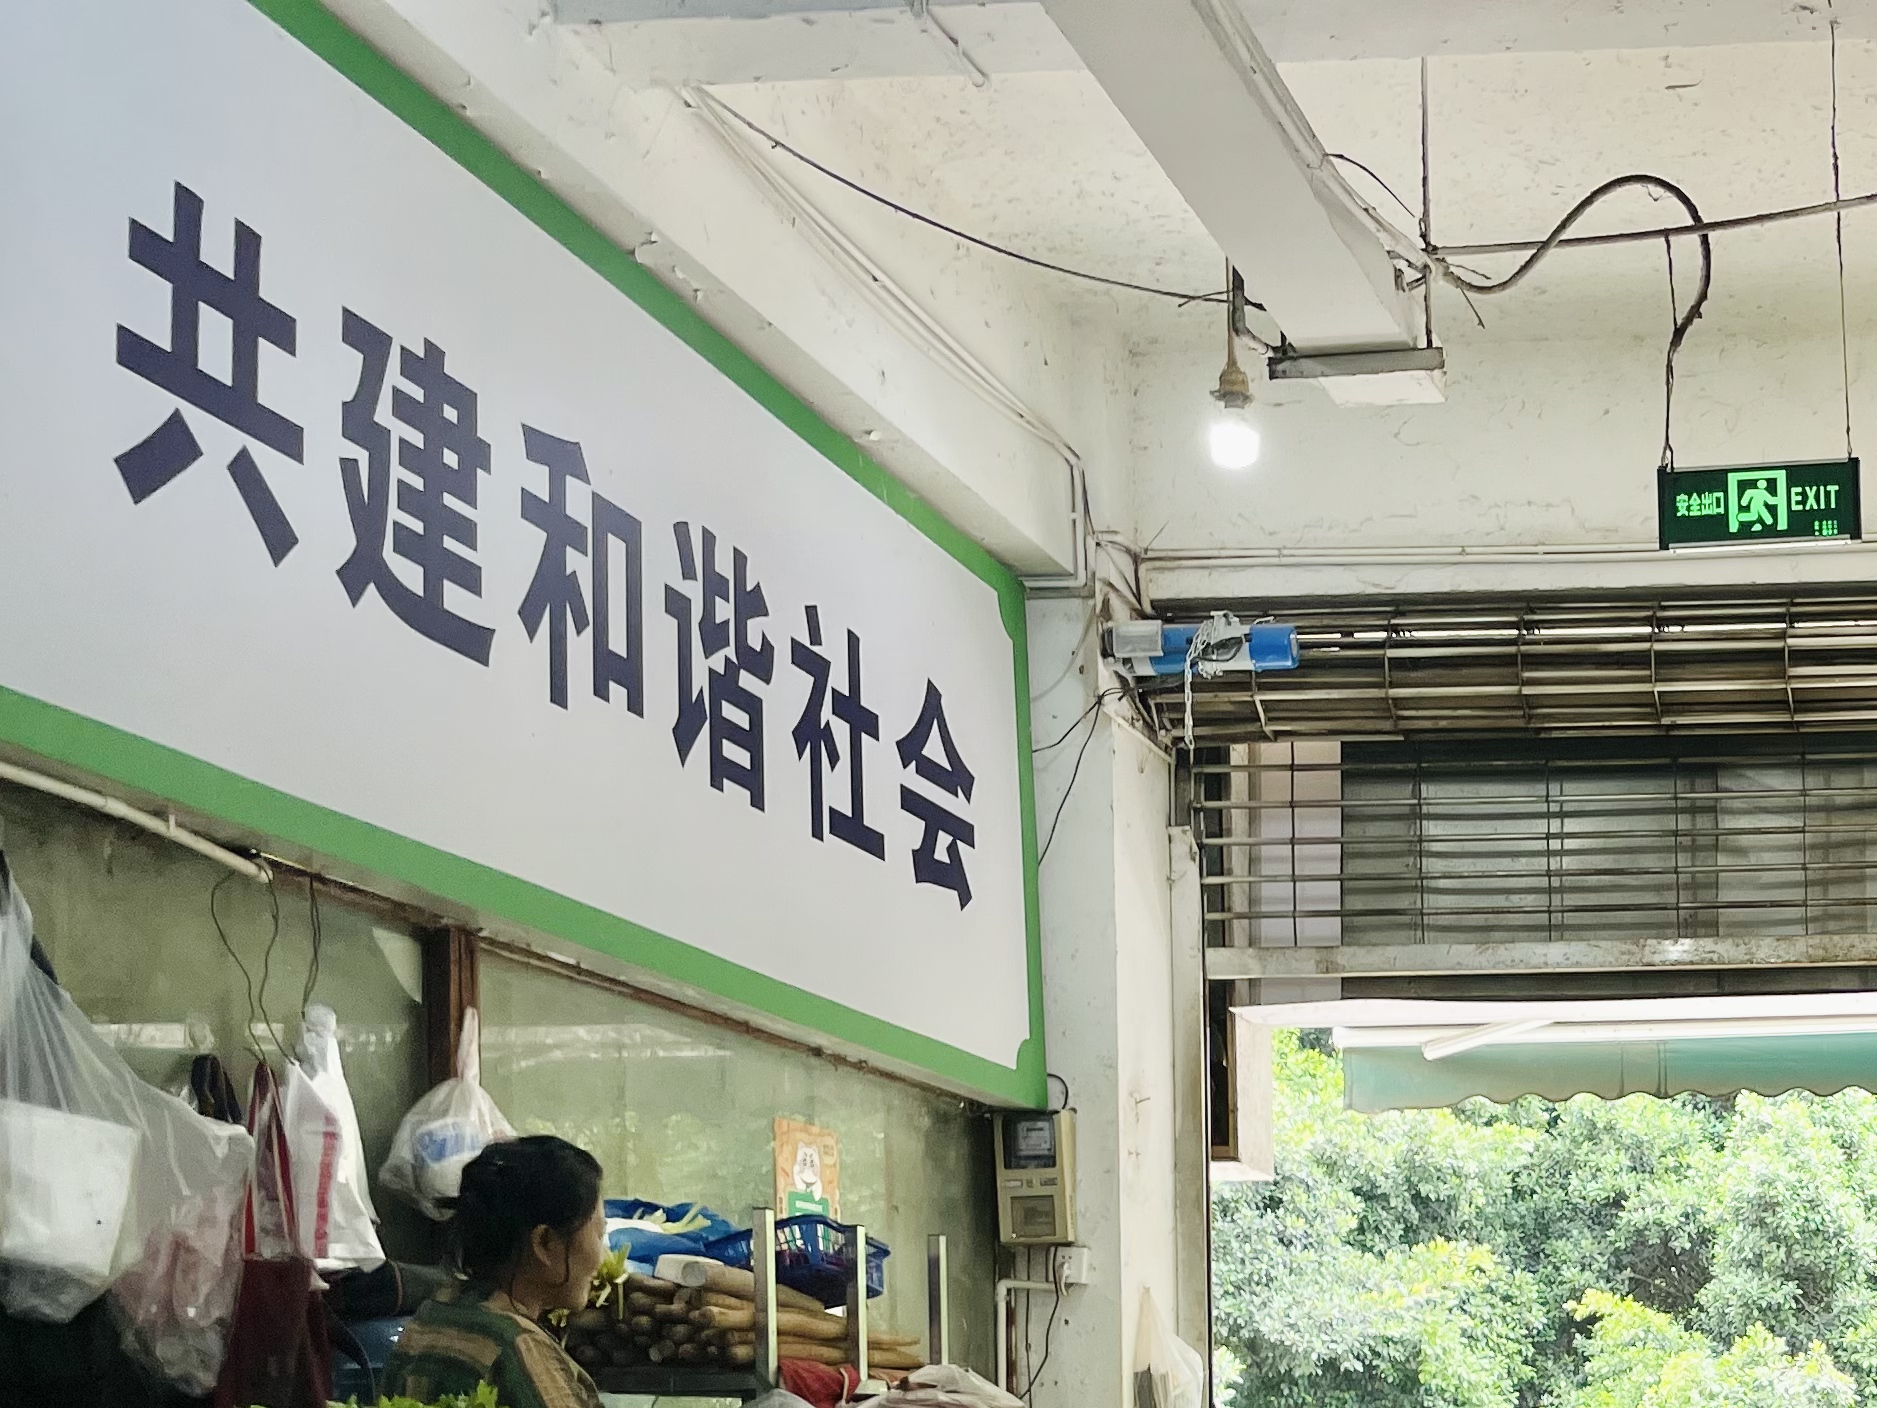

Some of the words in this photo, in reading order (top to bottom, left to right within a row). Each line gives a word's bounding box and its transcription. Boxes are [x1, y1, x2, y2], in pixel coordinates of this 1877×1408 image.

[1676, 491, 1725, 517] 安全出口
[1790, 485, 1839, 511] EXIT
[114, 181, 978, 910] 共建和谐社会
